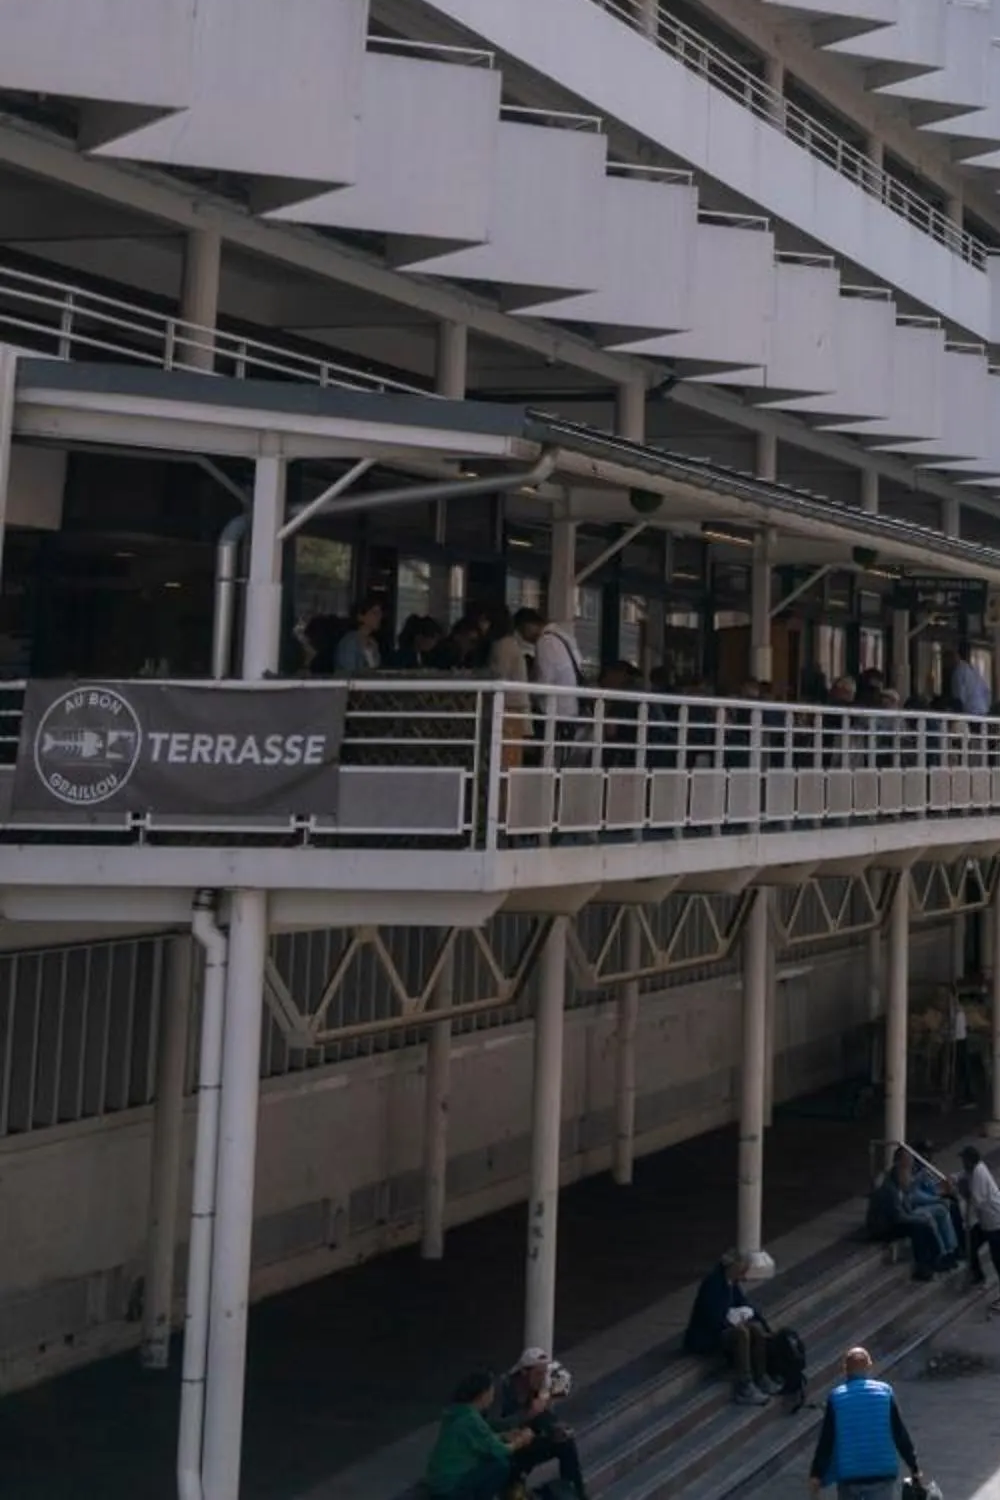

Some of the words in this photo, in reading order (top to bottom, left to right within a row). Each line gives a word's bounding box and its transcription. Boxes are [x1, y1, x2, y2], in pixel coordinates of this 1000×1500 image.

[65, 692, 86, 715] AU
[88, 692, 123, 715] BON
[148, 732, 327, 765] TERRASSE
[50, 772, 119, 800] GRAILLOU
